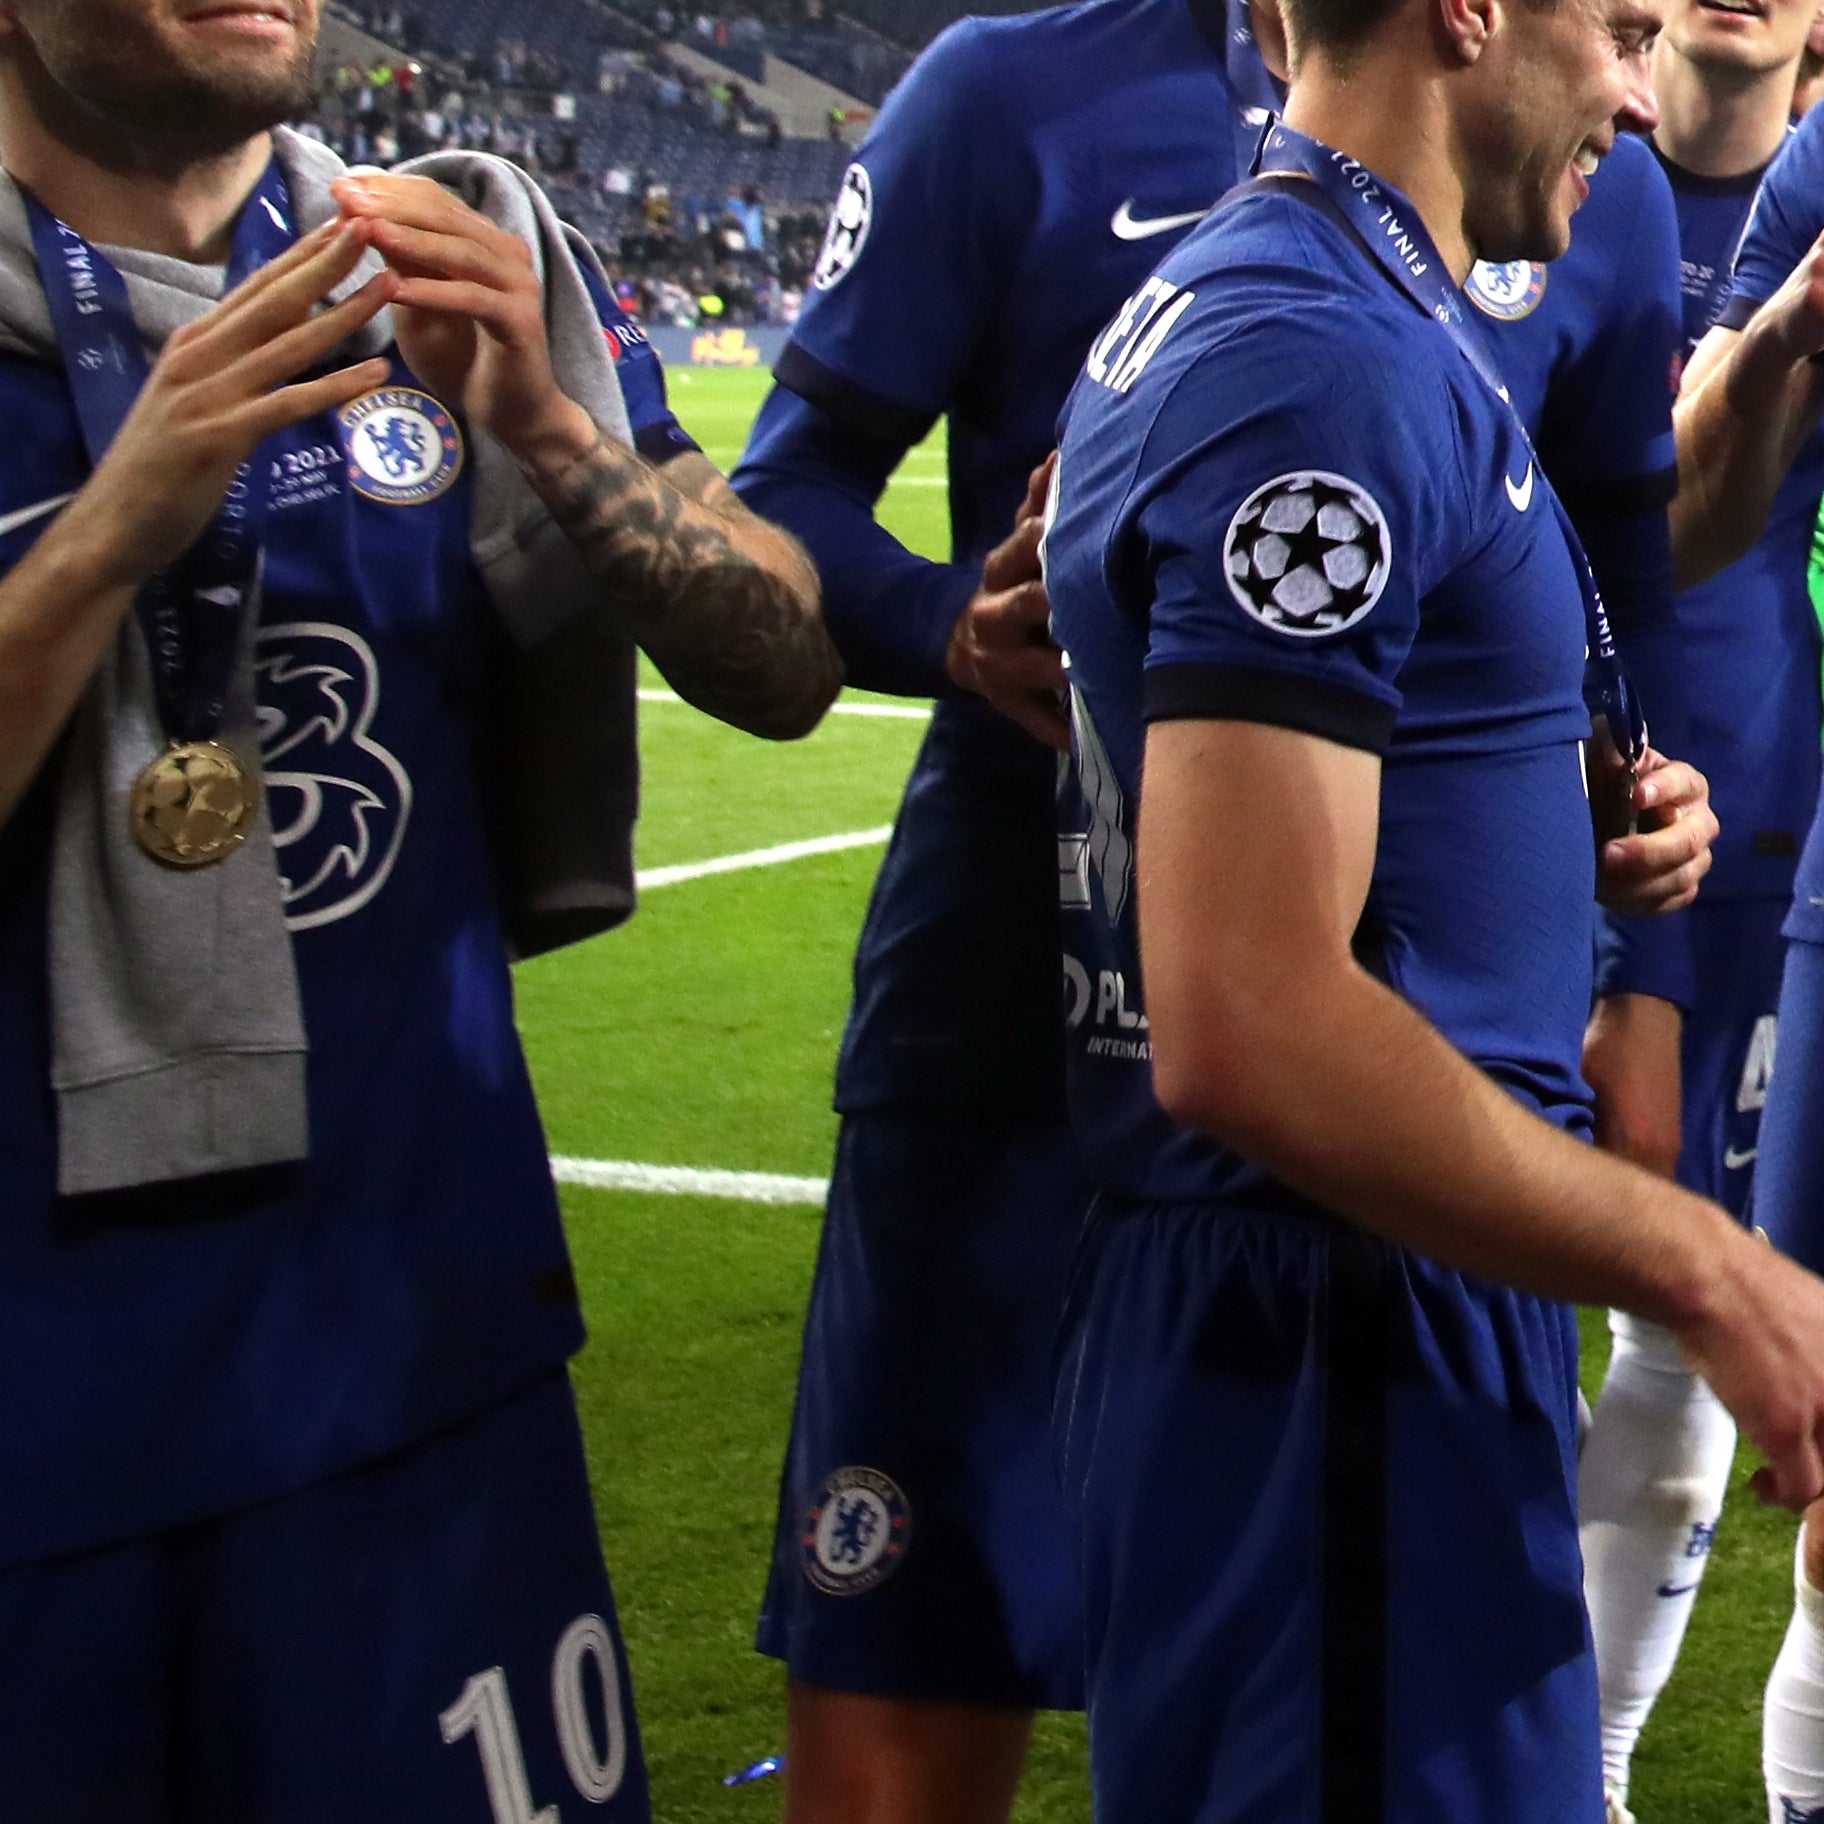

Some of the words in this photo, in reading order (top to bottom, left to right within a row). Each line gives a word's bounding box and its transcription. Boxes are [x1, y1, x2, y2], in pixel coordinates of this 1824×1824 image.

[1378, 205, 1428, 277] FINAL
[63, 242, 103, 315] FINAL
[438, 1612, 628, 1824] 10
